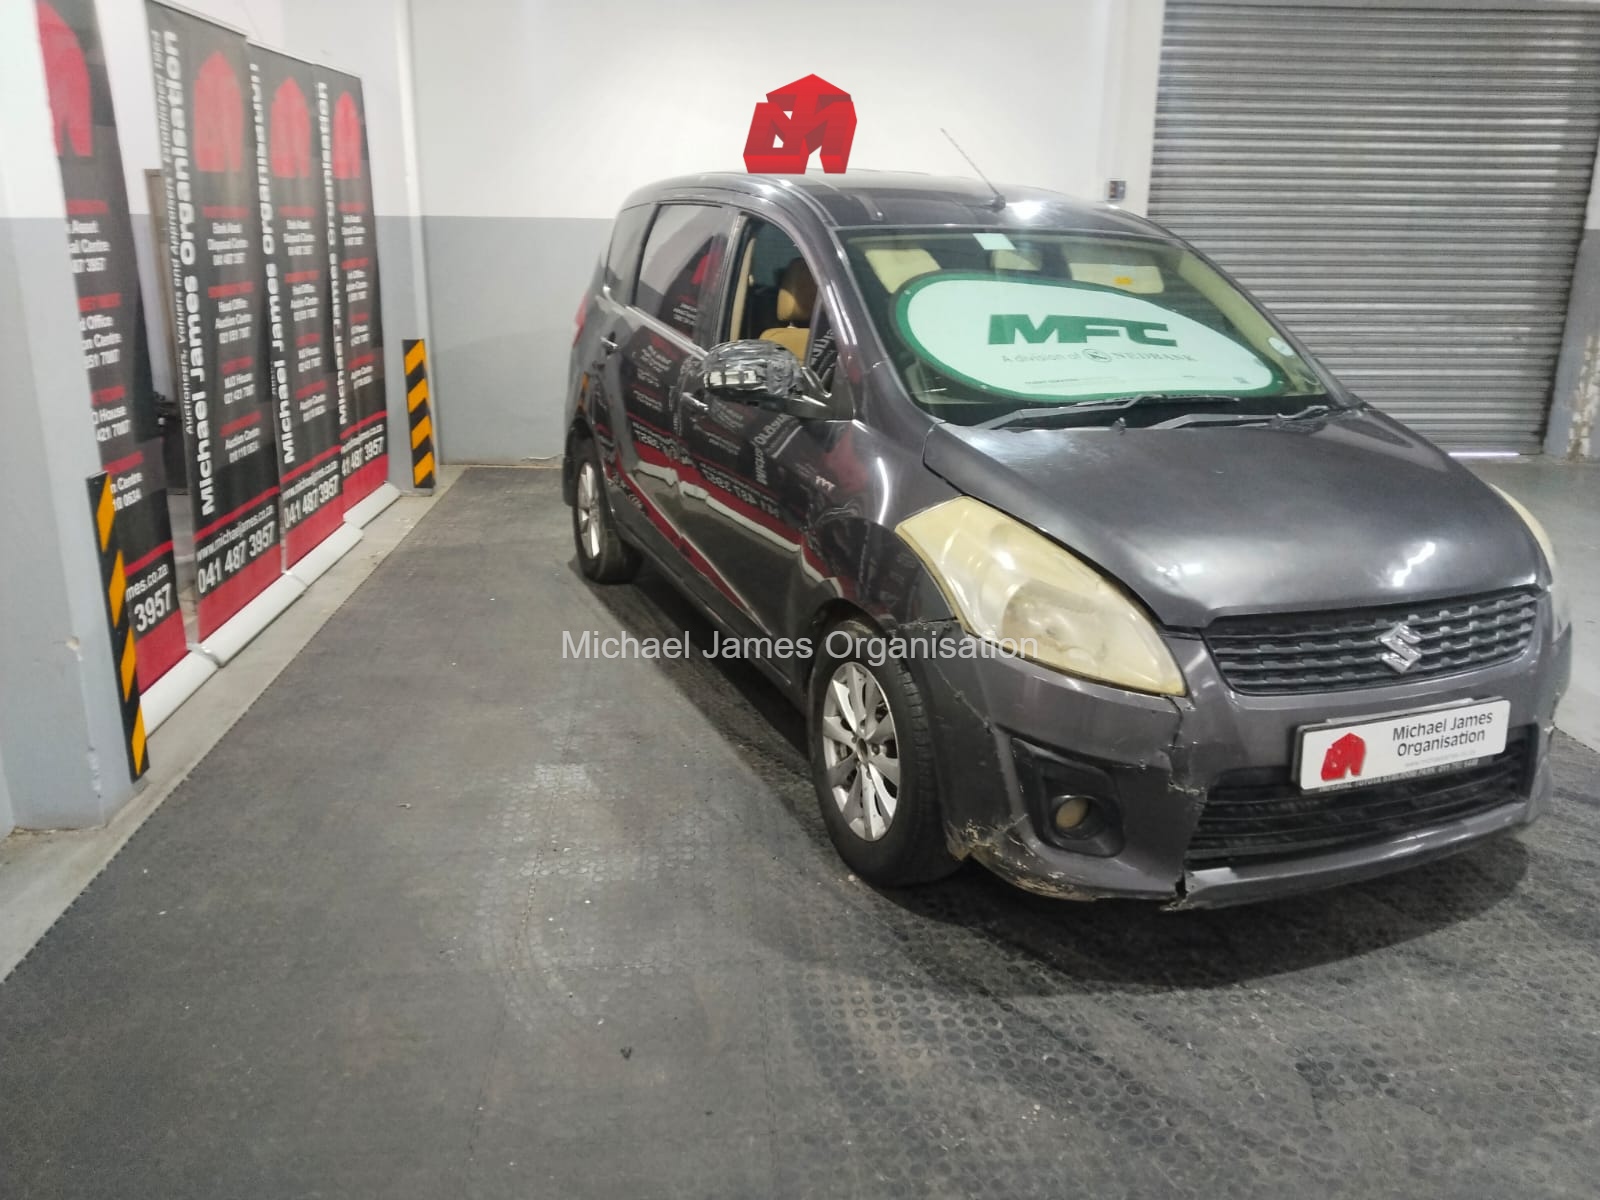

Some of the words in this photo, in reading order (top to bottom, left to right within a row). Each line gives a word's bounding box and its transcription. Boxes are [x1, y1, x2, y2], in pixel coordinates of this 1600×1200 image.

[163, 30, 195, 266] Organisation
[184, 275, 205, 383] James
[265, 263, 284, 352] James
[988, 314, 1178, 347] MFC
[274, 360, 295, 465] Michael
[334, 335, 348, 425] Michael
[192, 391, 216, 516] Michael
[284, 499, 301, 529] 041
[302, 488, 319, 514] 487
[319, 474, 339, 504] 3957
[198, 557, 222, 594] 041
[225, 540, 247, 574] 487
[248, 520, 275, 557] 3957
[134, 582, 172, 632] 3957
[1393, 718, 1447, 741] Michael
[1450, 712, 1493, 731] James
[1397, 729, 1485, 757] Organisation
